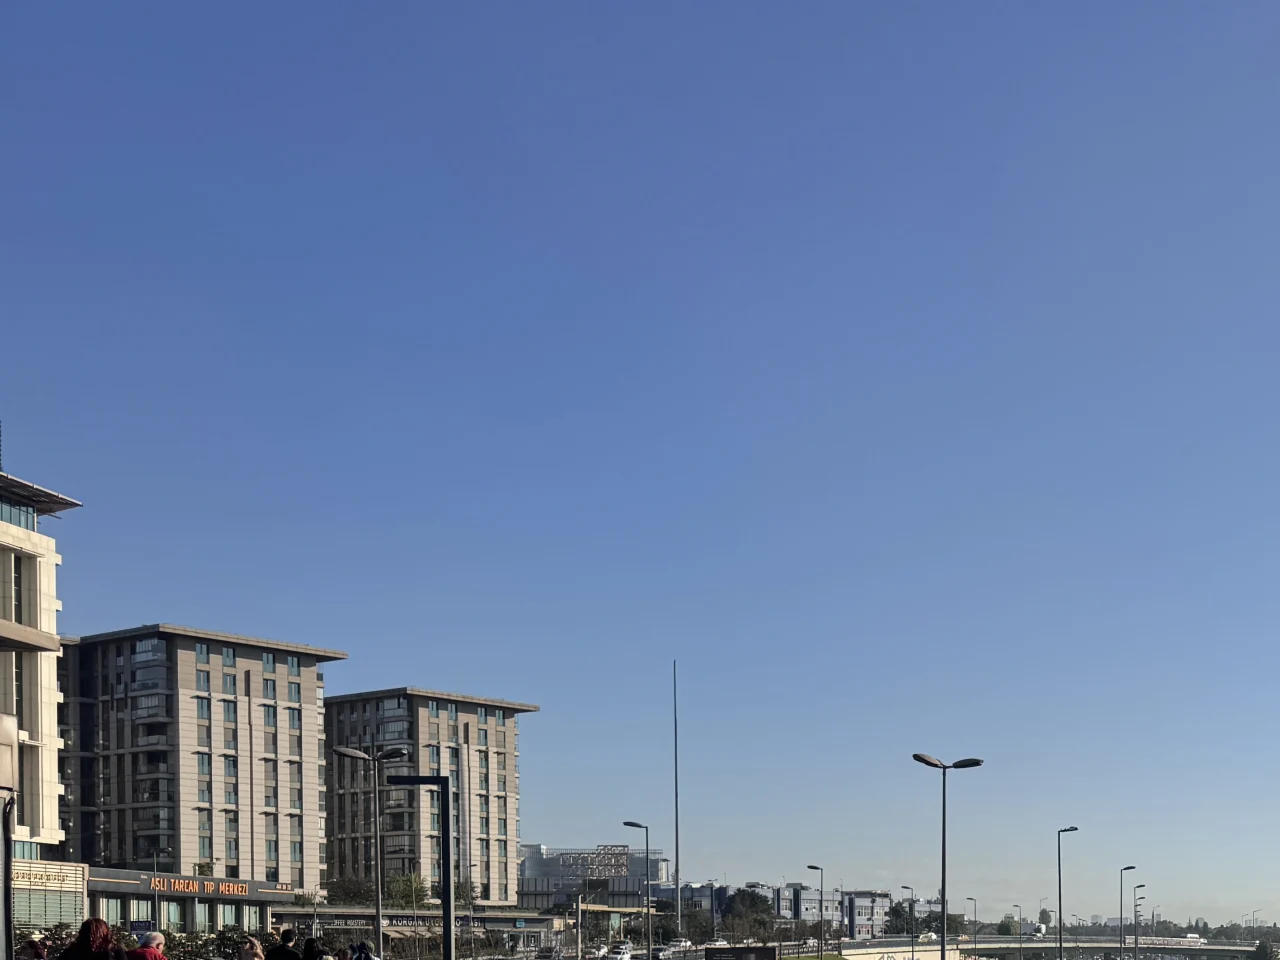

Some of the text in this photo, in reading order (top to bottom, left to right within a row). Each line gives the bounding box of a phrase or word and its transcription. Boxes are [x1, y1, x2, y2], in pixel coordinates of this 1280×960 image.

[150, 877, 249, 896] ASLI TARCAN TIP MERKEZİ
